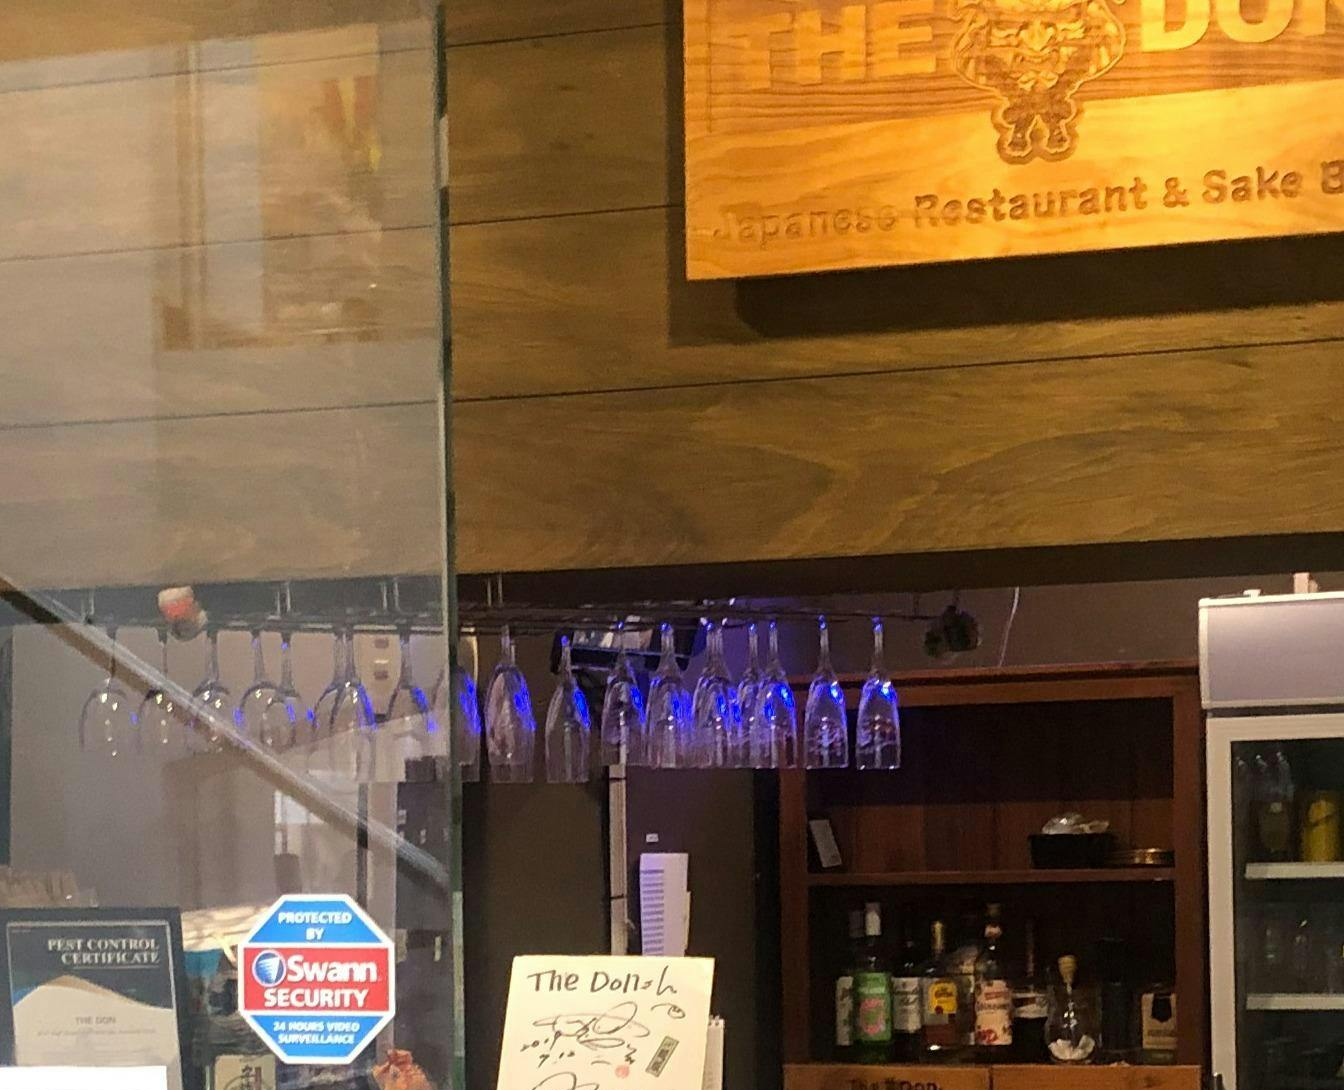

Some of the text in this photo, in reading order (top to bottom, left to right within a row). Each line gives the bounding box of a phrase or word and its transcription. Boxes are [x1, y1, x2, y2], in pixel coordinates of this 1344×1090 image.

[728, 0, 937, 89] THE
[713, 205, 897, 246] Japanese
[914, 176, 1149, 230] Restaurant
[1163, 177, 1190, 208] &
[1202, 166, 1303, 205] Sake
[277, 910, 352, 925] PROTECTED
[305, 927, 324, 941] BY
[47, 937, 160, 951] PEST CONTROL
[61, 951, 160, 965] CERTIFICATE
[286, 954, 378, 983] Swann
[527, 968, 580, 993] The
[263, 987, 369, 1008] SECURITY
[327, 1021, 360, 1032] VIDEO
